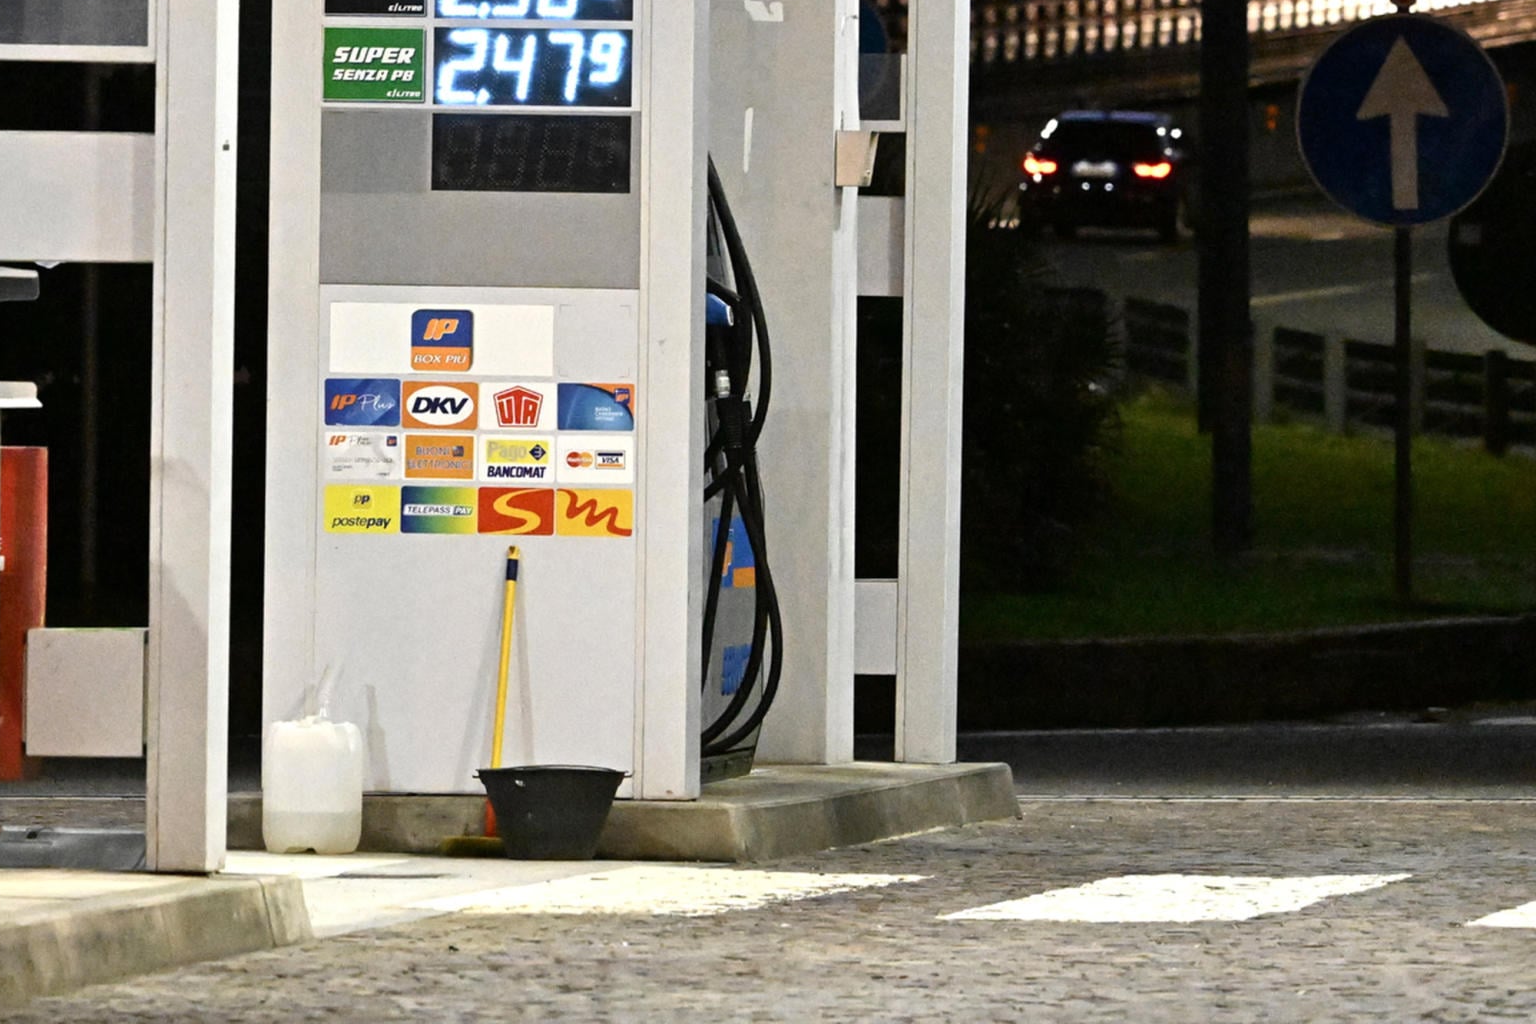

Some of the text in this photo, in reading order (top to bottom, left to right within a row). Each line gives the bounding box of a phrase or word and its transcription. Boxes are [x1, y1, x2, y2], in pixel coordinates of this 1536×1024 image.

[332, 47, 416, 65] SUPER
[332, 69, 387, 82] SENZA
[414, 354, 441, 364] BOX
[330, 393, 395, 411] IP Plus
[411, 396, 469, 415] DKV
[415, 446, 450, 457] BUONI
[487, 441, 527, 462] Pago
[601, 456, 620, 464] VISA
[487, 465, 547, 479] BANCOMAT
[407, 506, 451, 514] TELEPASS
[332, 516, 392, 529] postepay
